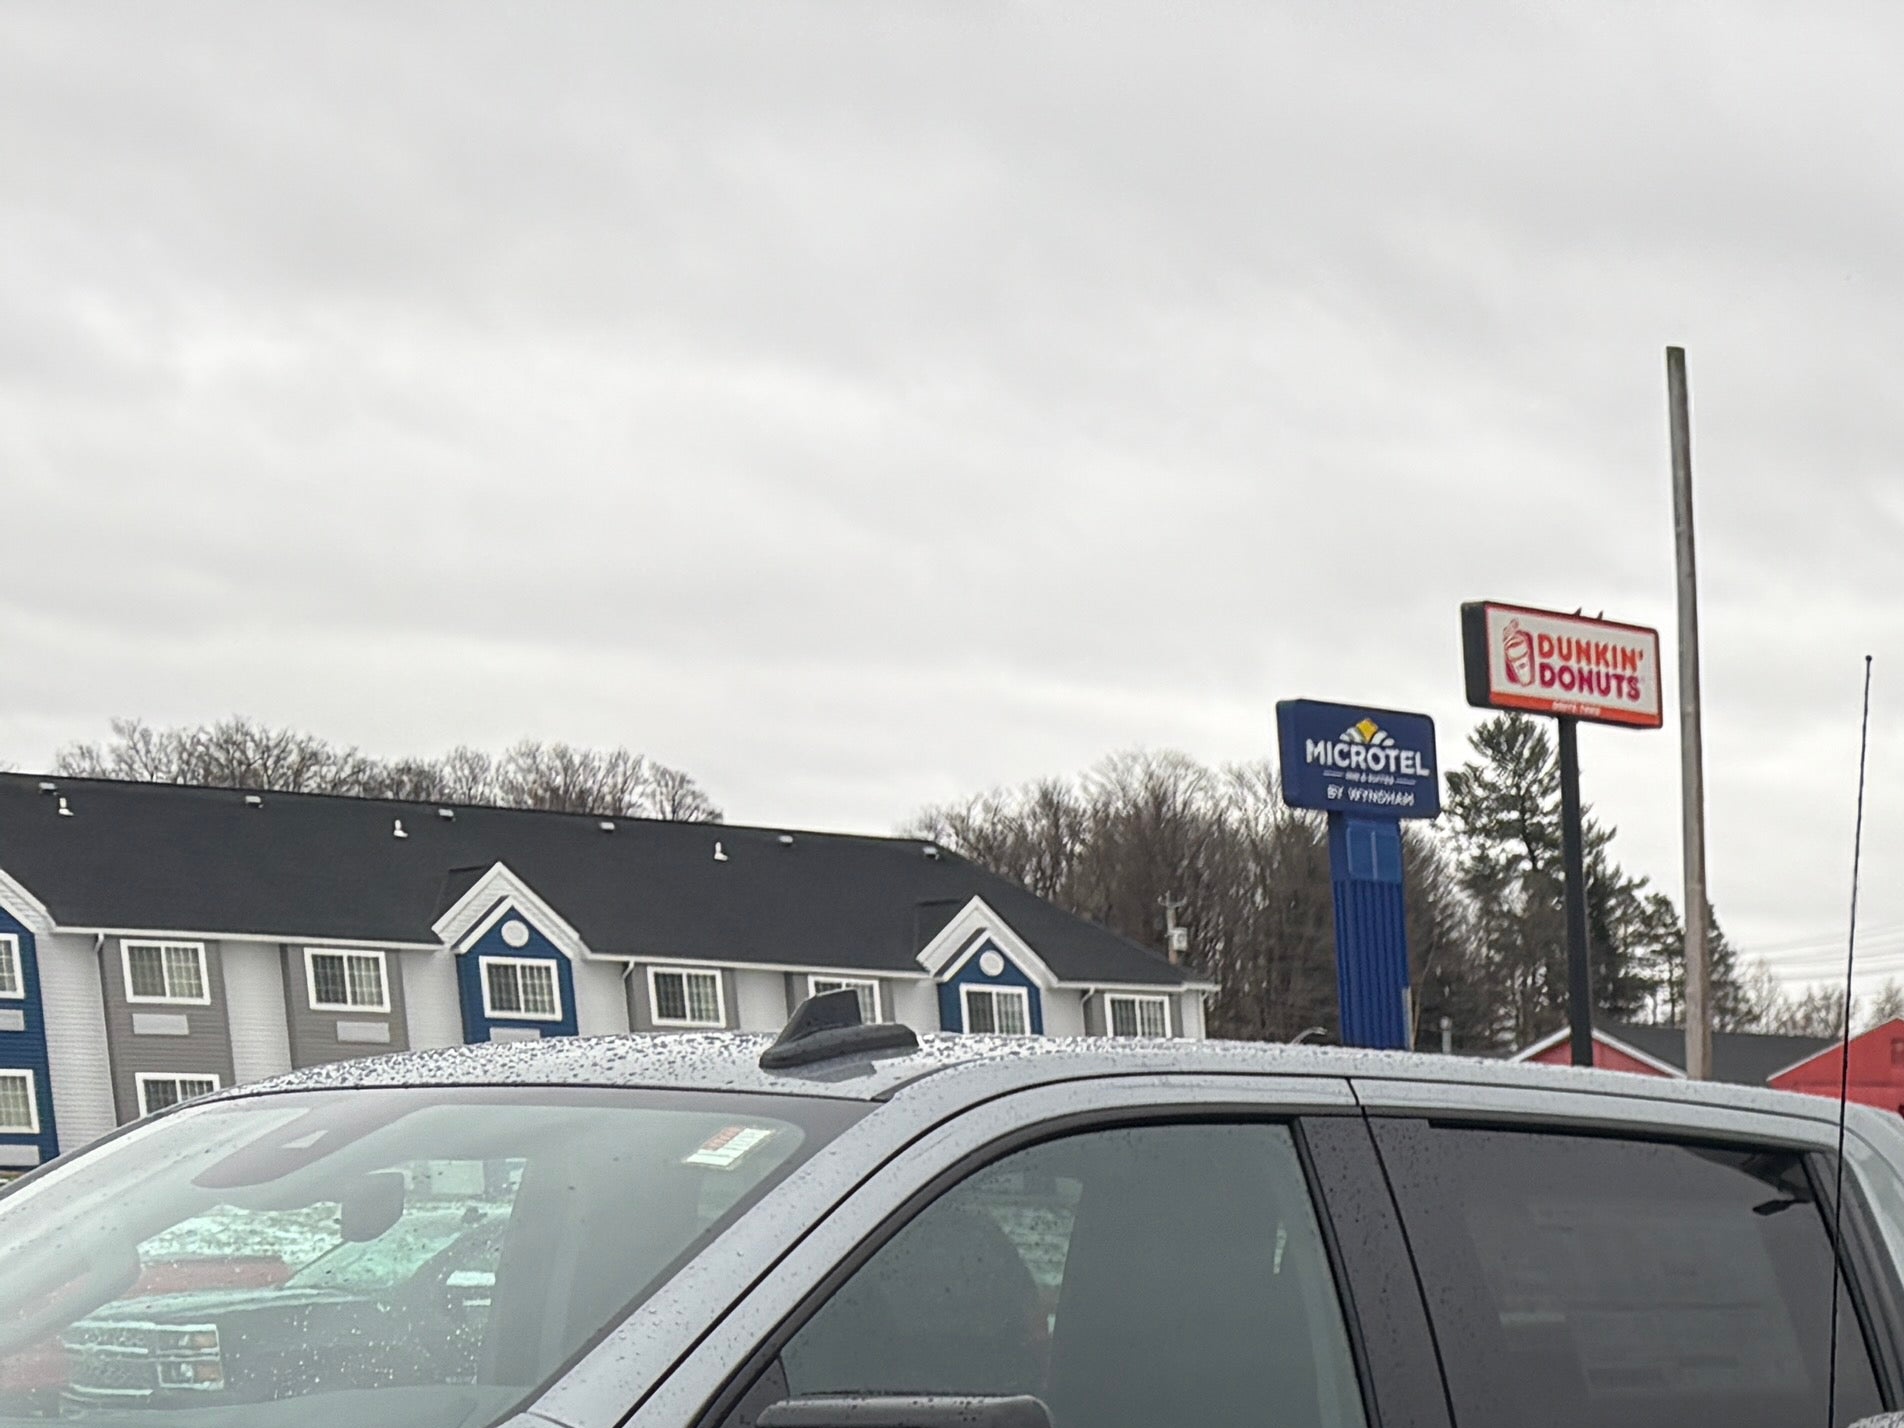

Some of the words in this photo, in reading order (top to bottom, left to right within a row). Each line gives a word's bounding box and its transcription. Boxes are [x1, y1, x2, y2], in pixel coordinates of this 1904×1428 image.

[1537, 633, 1643, 673] DUNKIN'
[1539, 662, 1641, 702] DONUTS
[1305, 738, 1430, 776] MICROTEL
